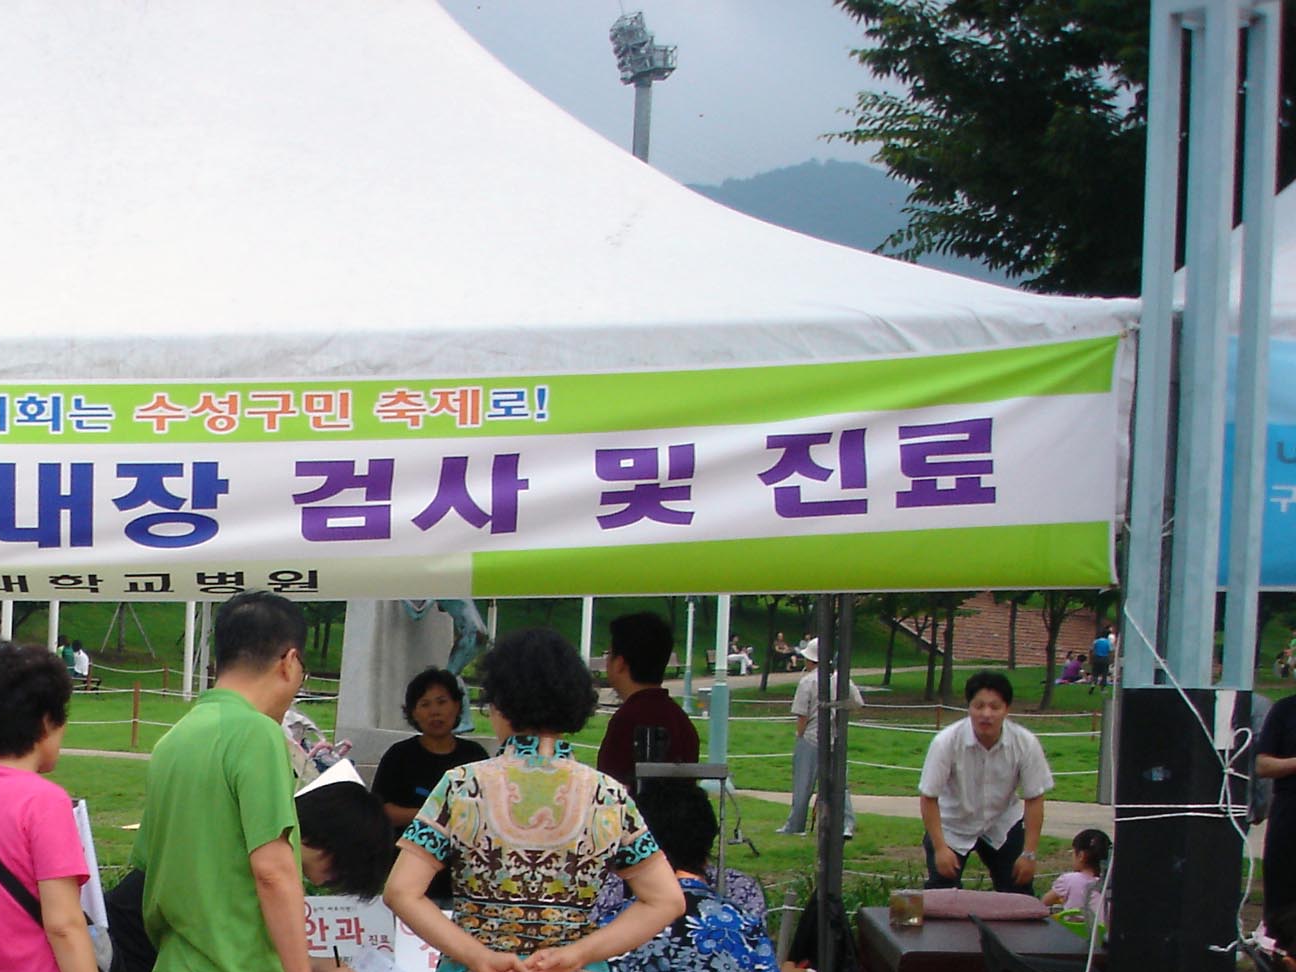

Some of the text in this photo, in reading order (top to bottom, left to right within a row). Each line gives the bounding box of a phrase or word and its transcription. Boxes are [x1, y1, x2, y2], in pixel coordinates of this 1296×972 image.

[134, 392, 352, 431] 수성구민
[375, 386, 549, 427] 축제로!
[292, 453, 529, 542] 검사
[595, 443, 695, 530] 및
[757, 417, 997, 519] 진료
